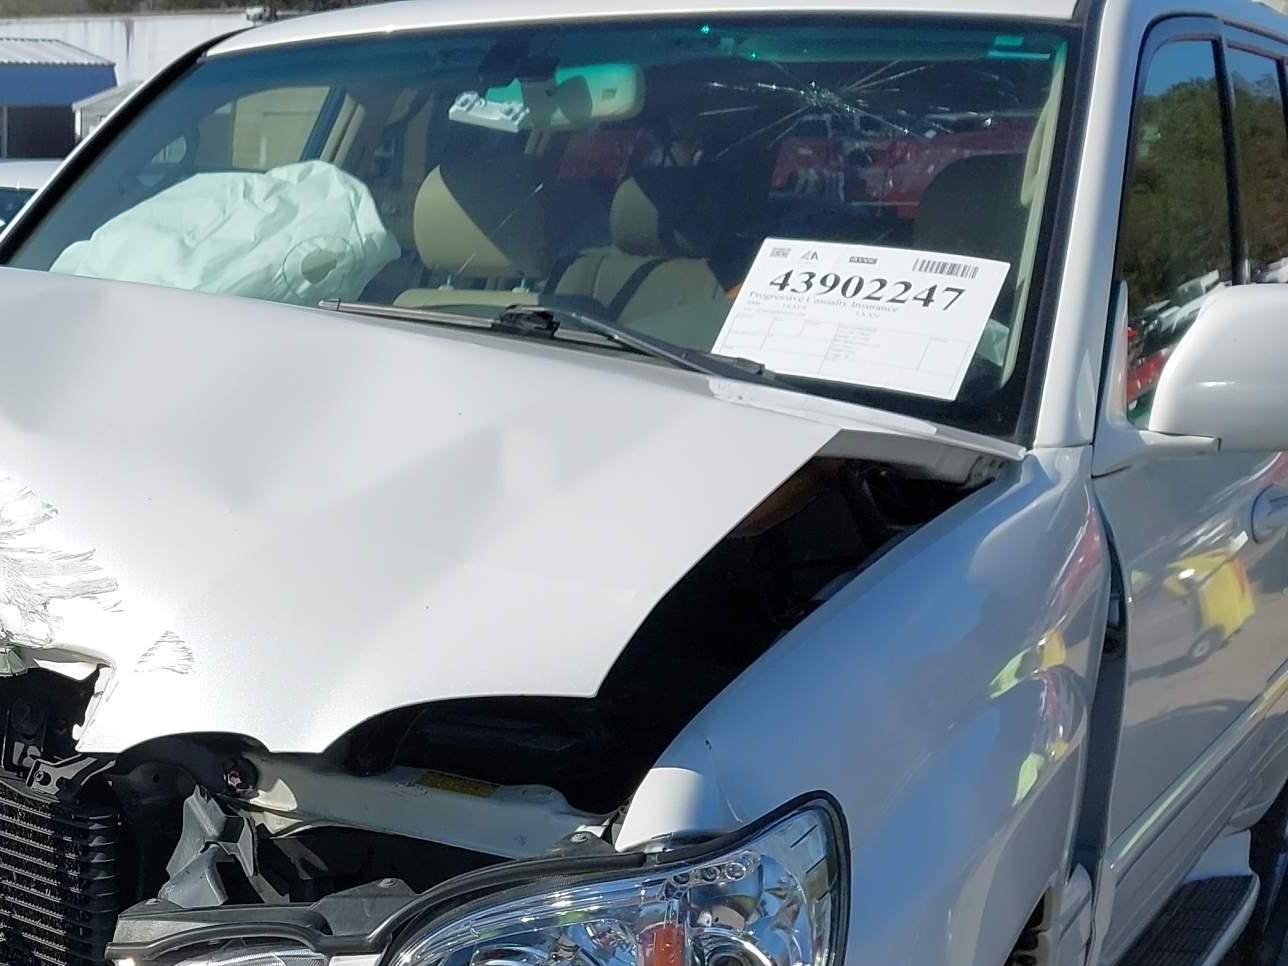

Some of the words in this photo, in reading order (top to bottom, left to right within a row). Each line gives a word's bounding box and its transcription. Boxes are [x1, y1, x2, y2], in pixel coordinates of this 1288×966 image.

[769, 269, 966, 311] 43902247
[806, 296, 848, 309] Casualty
[850, 300, 899, 312] Insurance
